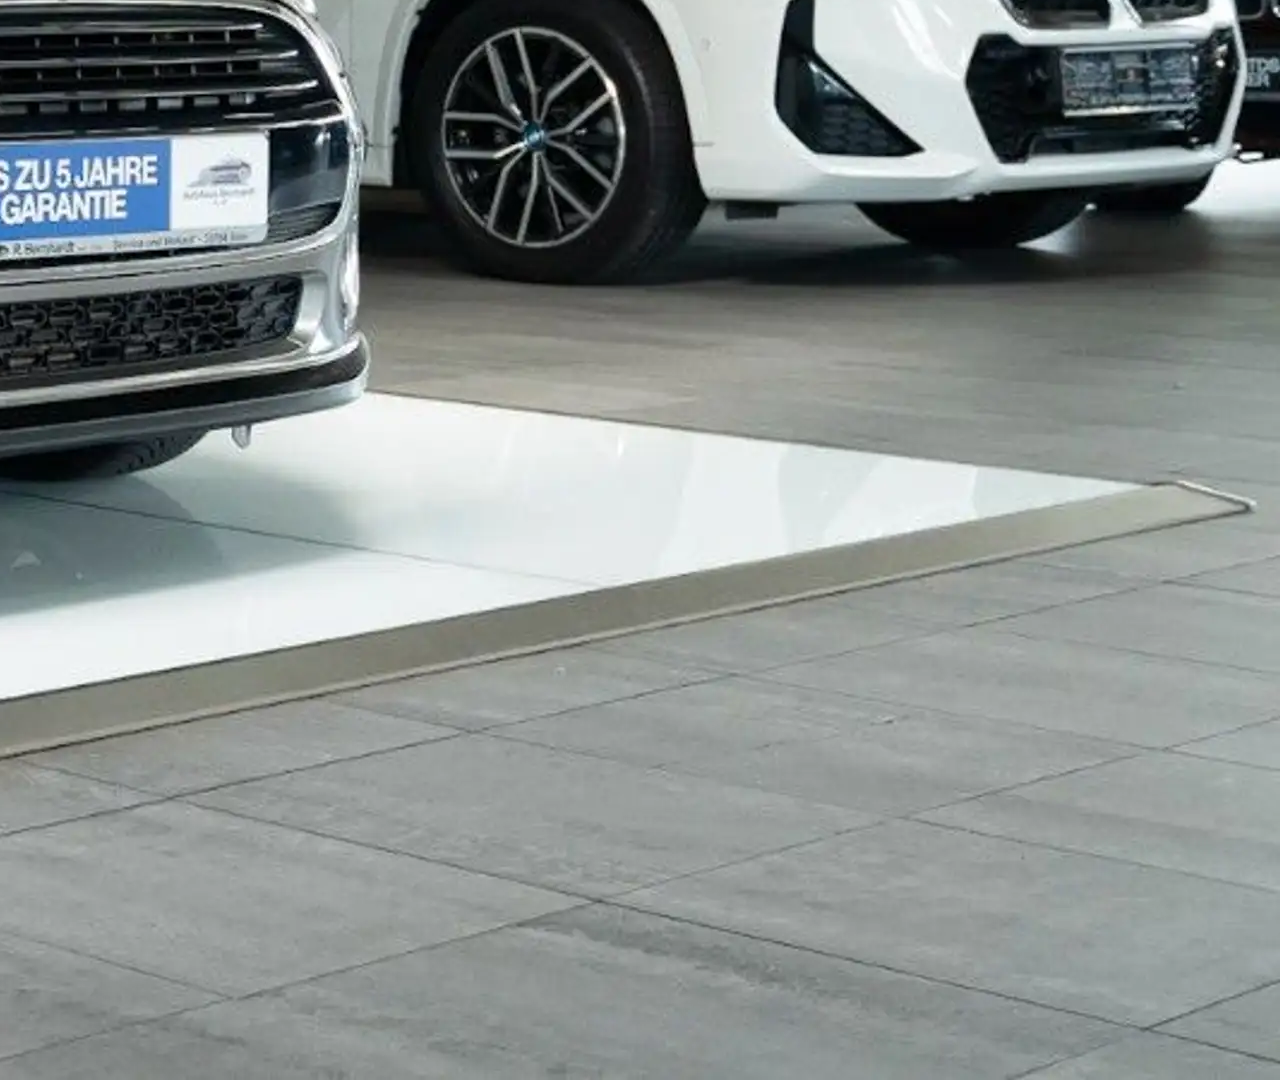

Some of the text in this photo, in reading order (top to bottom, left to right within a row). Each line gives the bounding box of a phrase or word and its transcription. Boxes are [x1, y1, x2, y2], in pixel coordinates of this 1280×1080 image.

[14, 157, 51, 191] ZU
[55, 157, 71, 189] 5
[74, 155, 159, 189] JAHRE
[0, 189, 129, 225] GARANTIE
